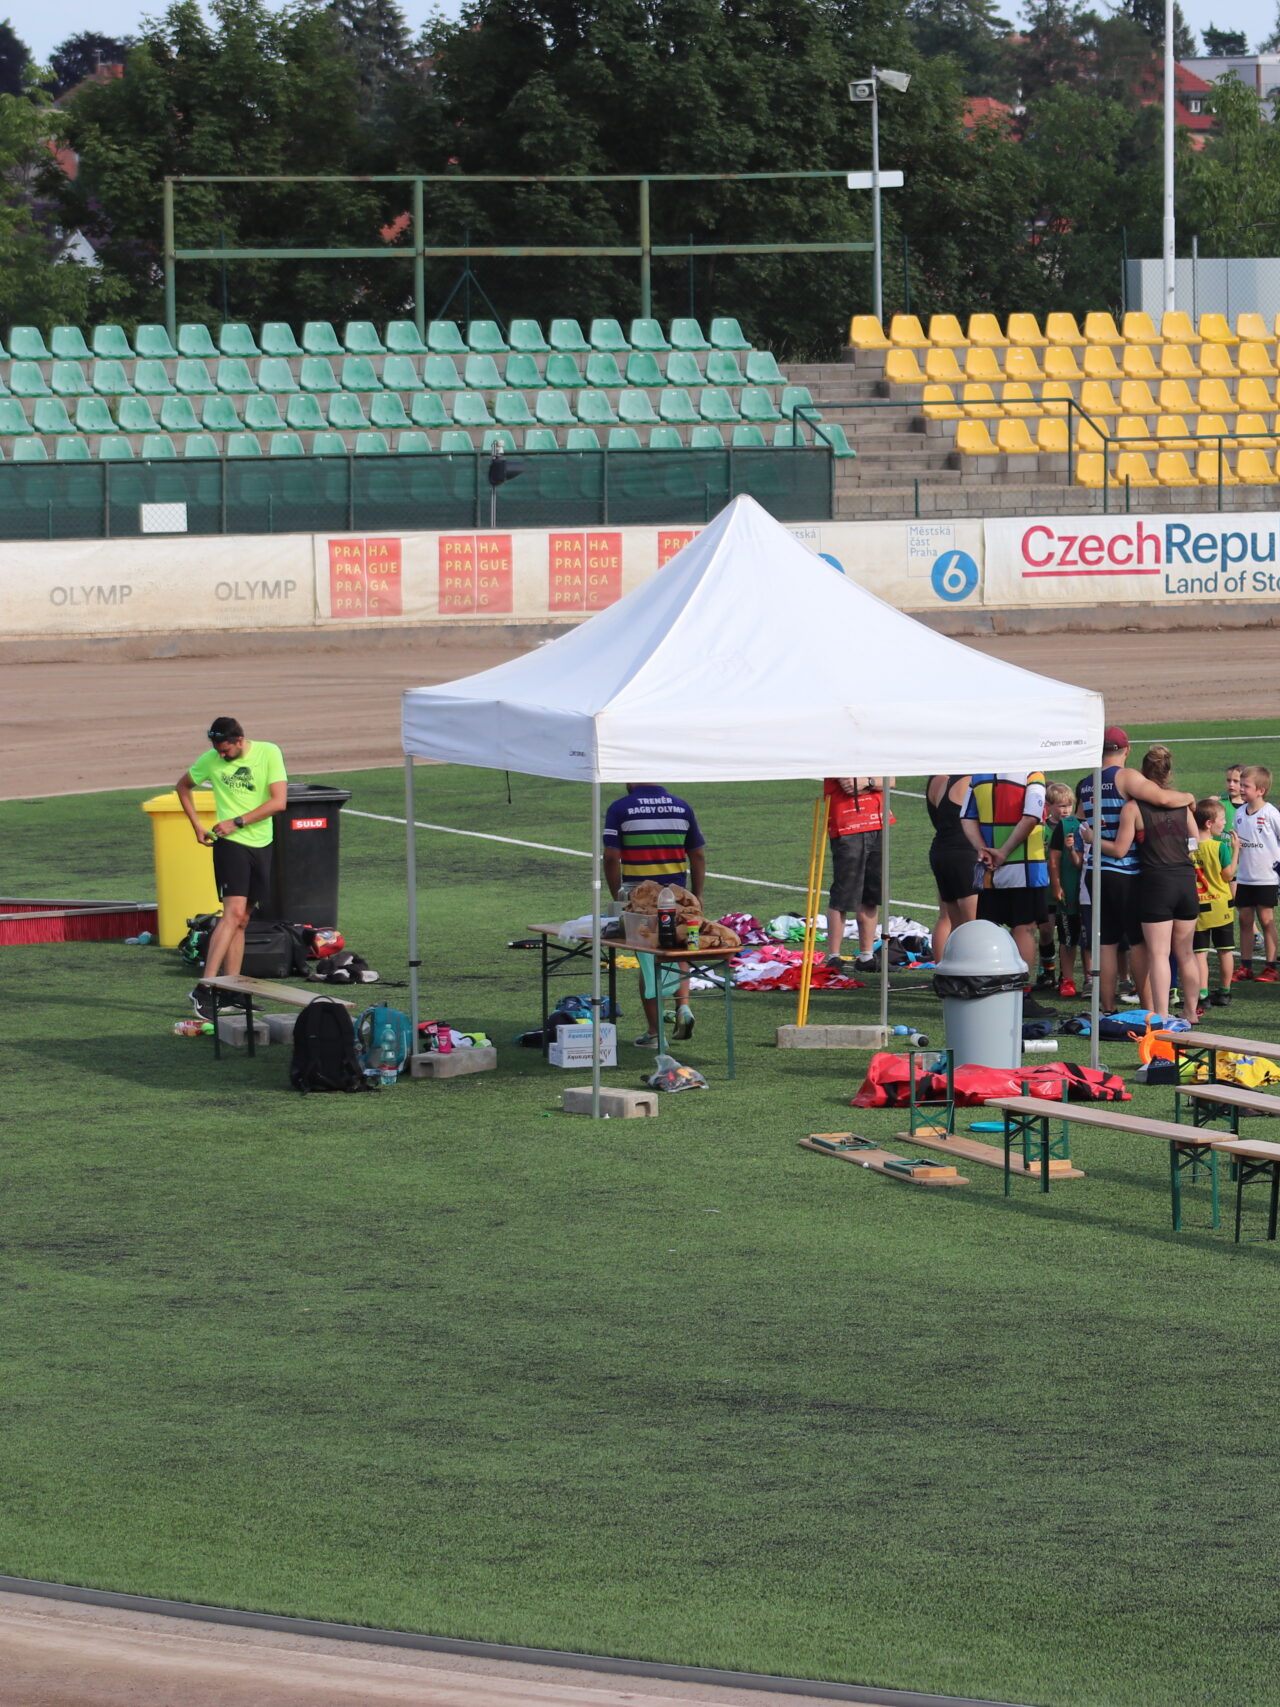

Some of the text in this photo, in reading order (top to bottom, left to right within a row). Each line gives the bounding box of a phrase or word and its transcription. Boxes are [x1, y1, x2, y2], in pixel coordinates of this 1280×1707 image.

[910, 547, 938, 557] Praha
[943, 555, 966, 594] 6
[1165, 572, 1218, 594] Land
[1224, 571, 1247, 592] of
[50, 585, 132, 606] OLYMP
[214, 580, 297, 601] OLYMP
[627, 806, 657, 815] RAGBY
[296, 820, 323, 828] SULO
